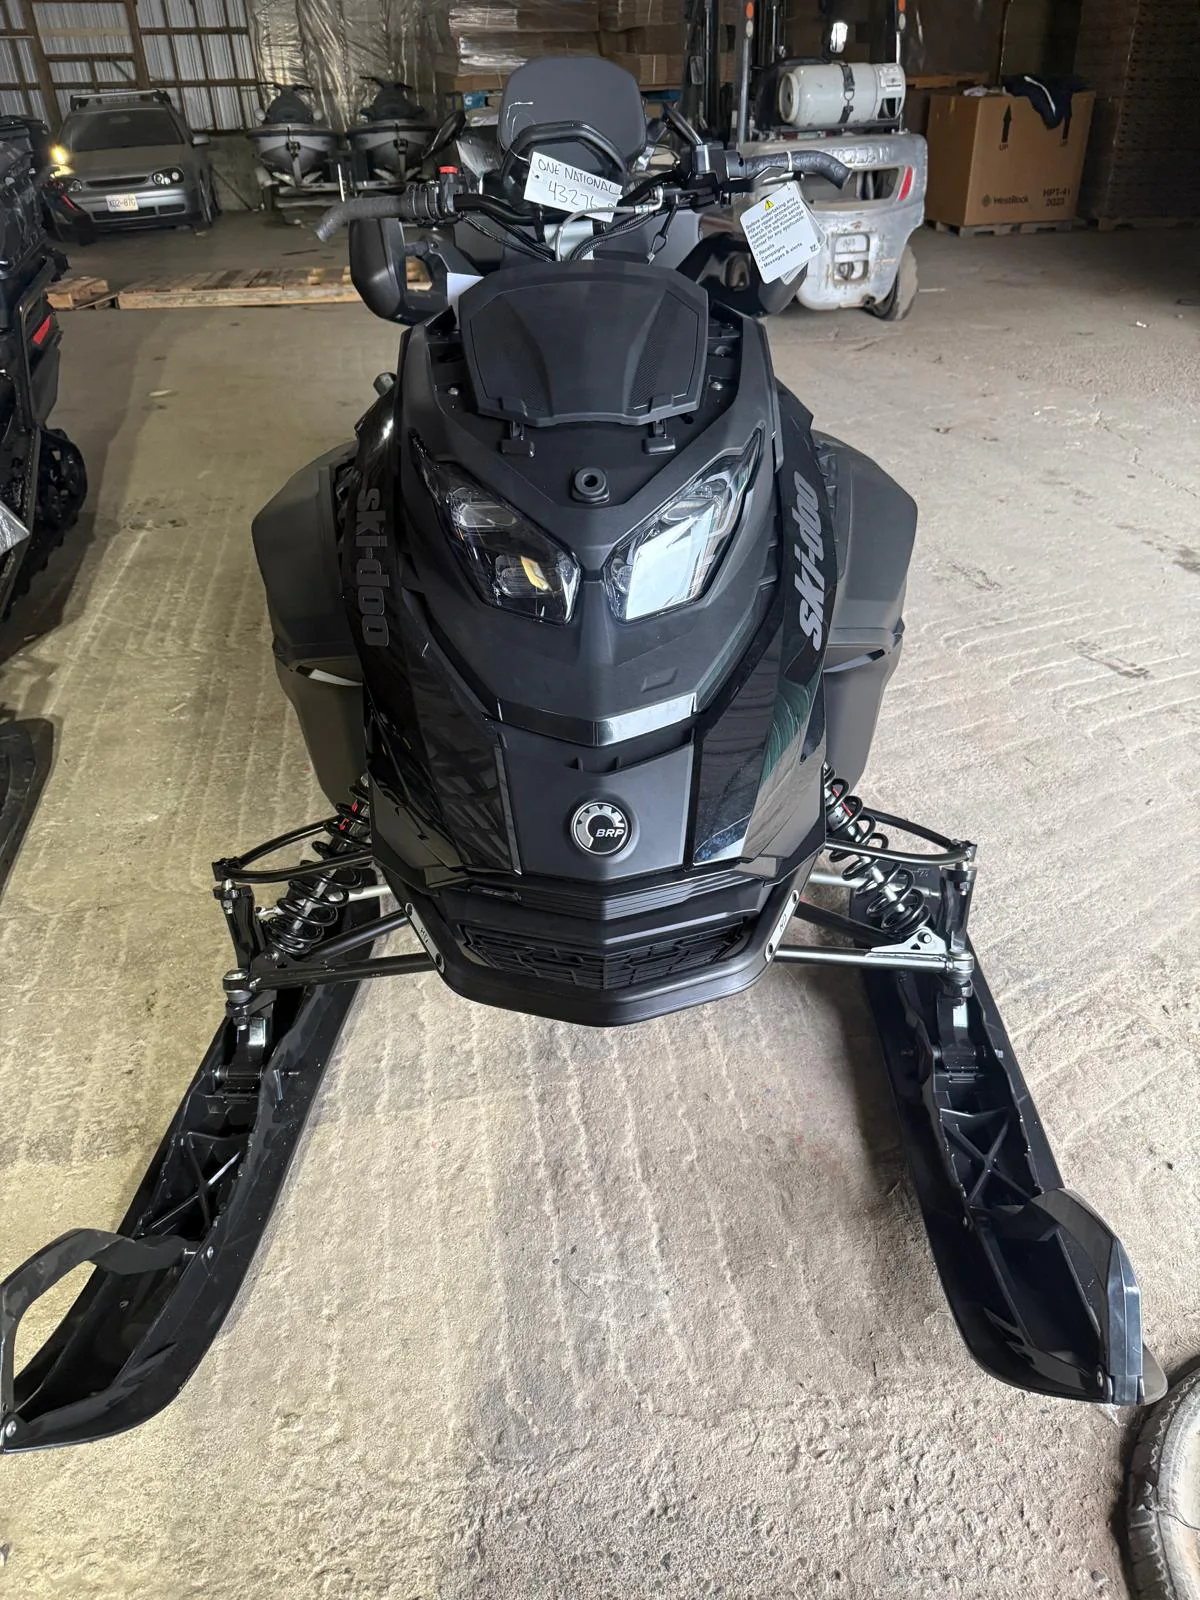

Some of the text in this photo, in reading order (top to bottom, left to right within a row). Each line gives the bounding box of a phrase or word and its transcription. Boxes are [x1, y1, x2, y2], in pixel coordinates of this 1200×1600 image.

[538, 159, 621, 196] ONE NATIONAL
[773, 213, 787, 225] vehicle
[789, 205, 800, 215] serial
[595, 828, 625, 838] BRP
